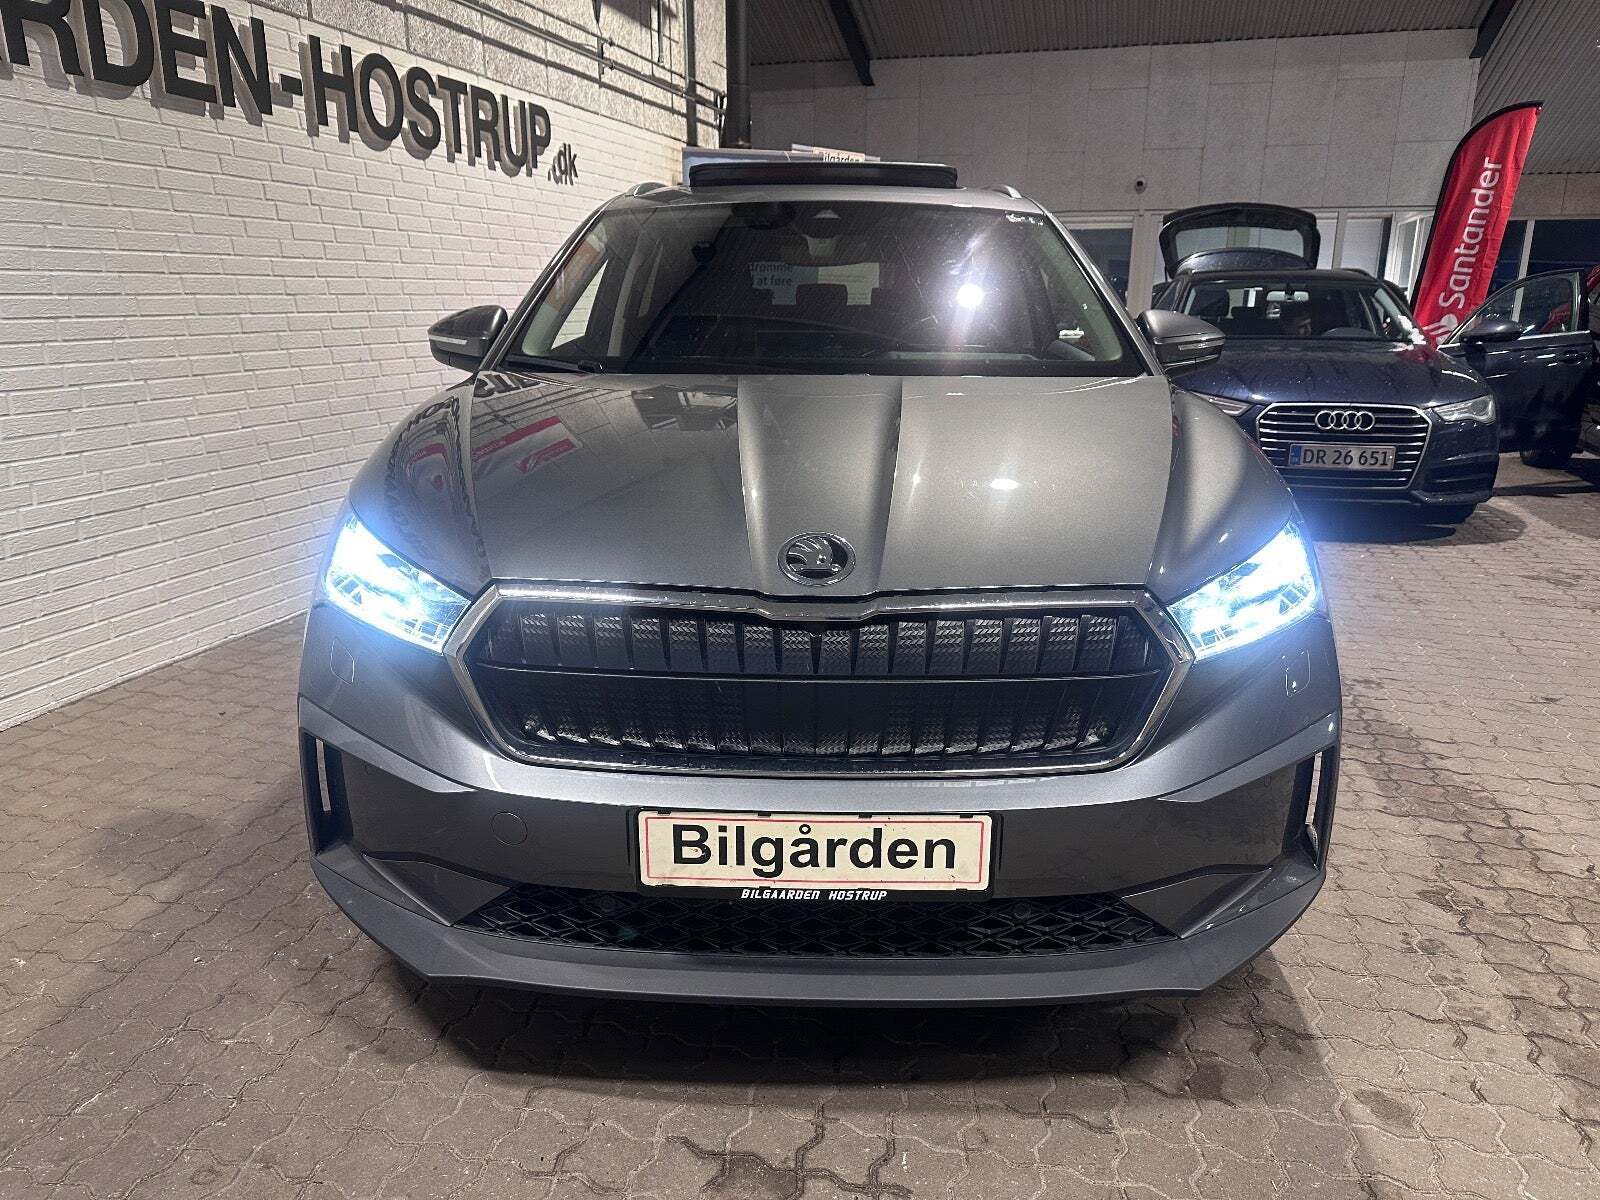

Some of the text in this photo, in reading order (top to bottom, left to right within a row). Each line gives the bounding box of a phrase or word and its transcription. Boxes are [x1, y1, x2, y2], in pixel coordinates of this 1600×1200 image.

[1438, 156, 1502, 310] Santander
[1302, 448, 1389, 466] DR 26 651
[672, 824, 956, 878] Bilgården
[740, 888, 888, 901] BILGAARDEN HOSTRUP
